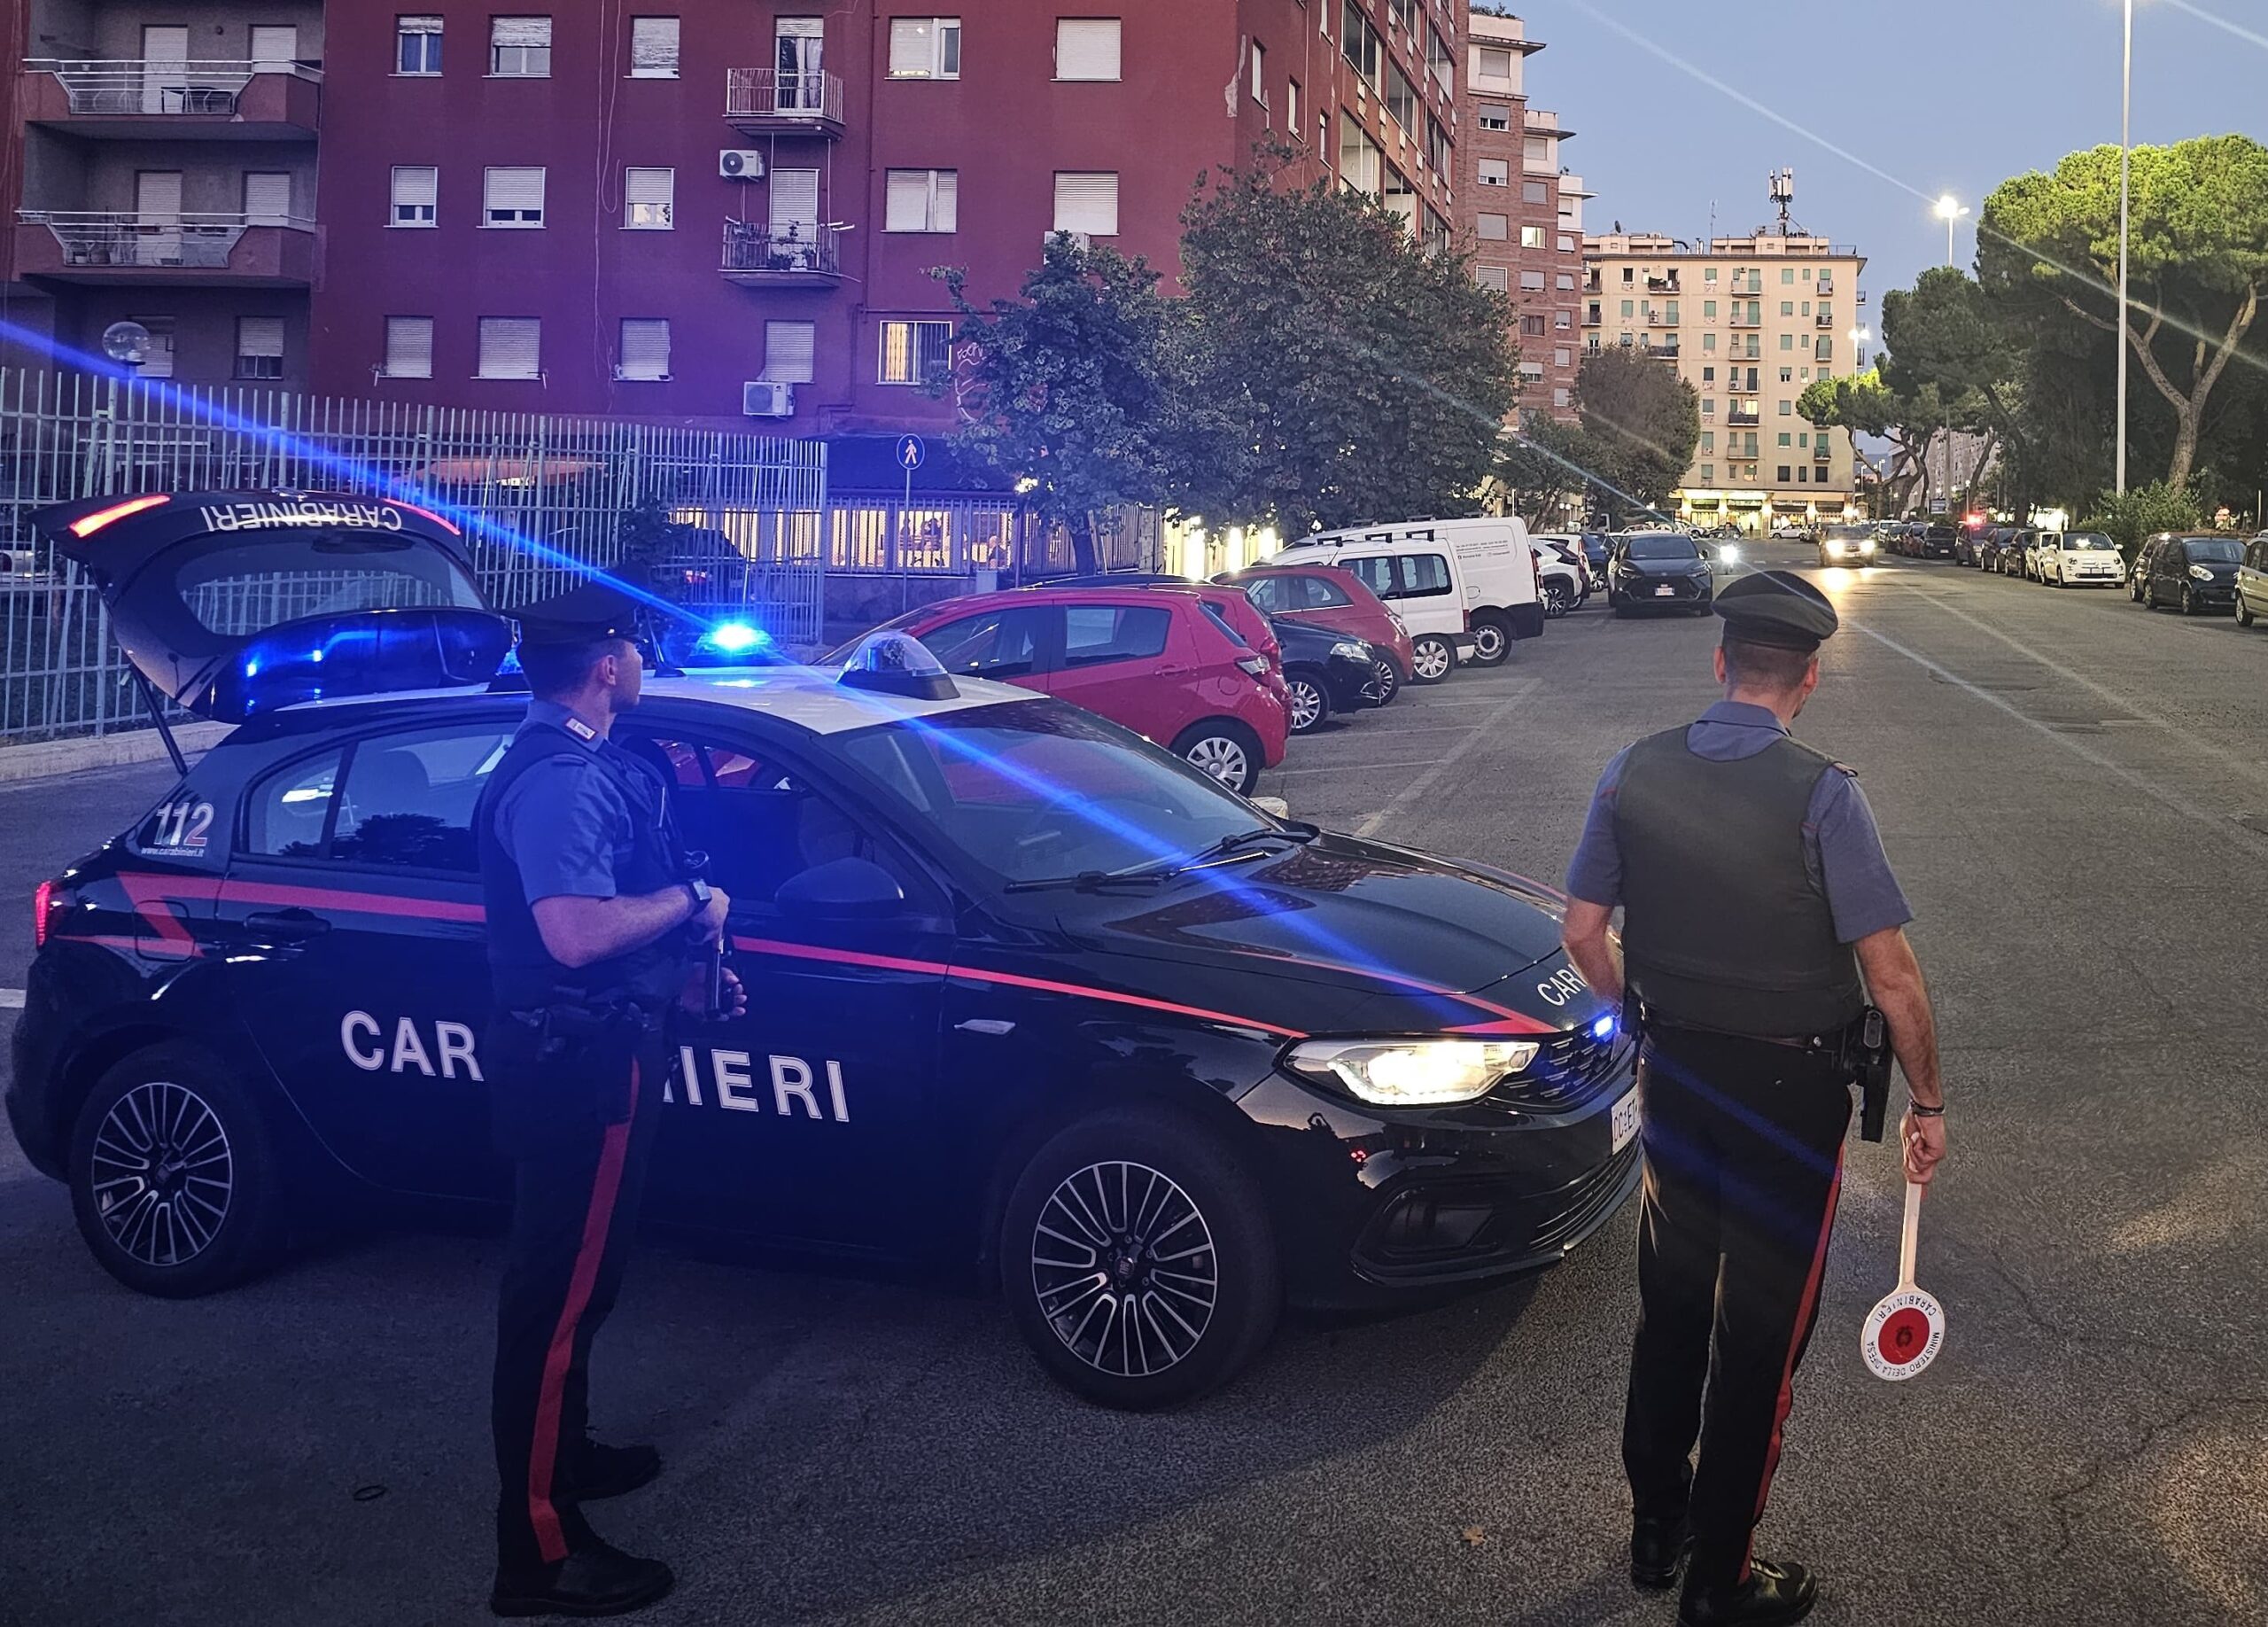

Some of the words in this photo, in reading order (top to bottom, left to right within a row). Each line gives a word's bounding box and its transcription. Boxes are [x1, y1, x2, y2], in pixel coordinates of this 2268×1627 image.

[200, 502, 402, 532] CARABINIERI
[153, 802, 214, 847] 112
[341, 1010, 849, 1122] CARIERI
[1875, 1295, 1937, 1323] CARABINIERI
[1909, 1332, 1940, 1372] MINISTERO
[1882, 1366, 1907, 1376] DELLA
